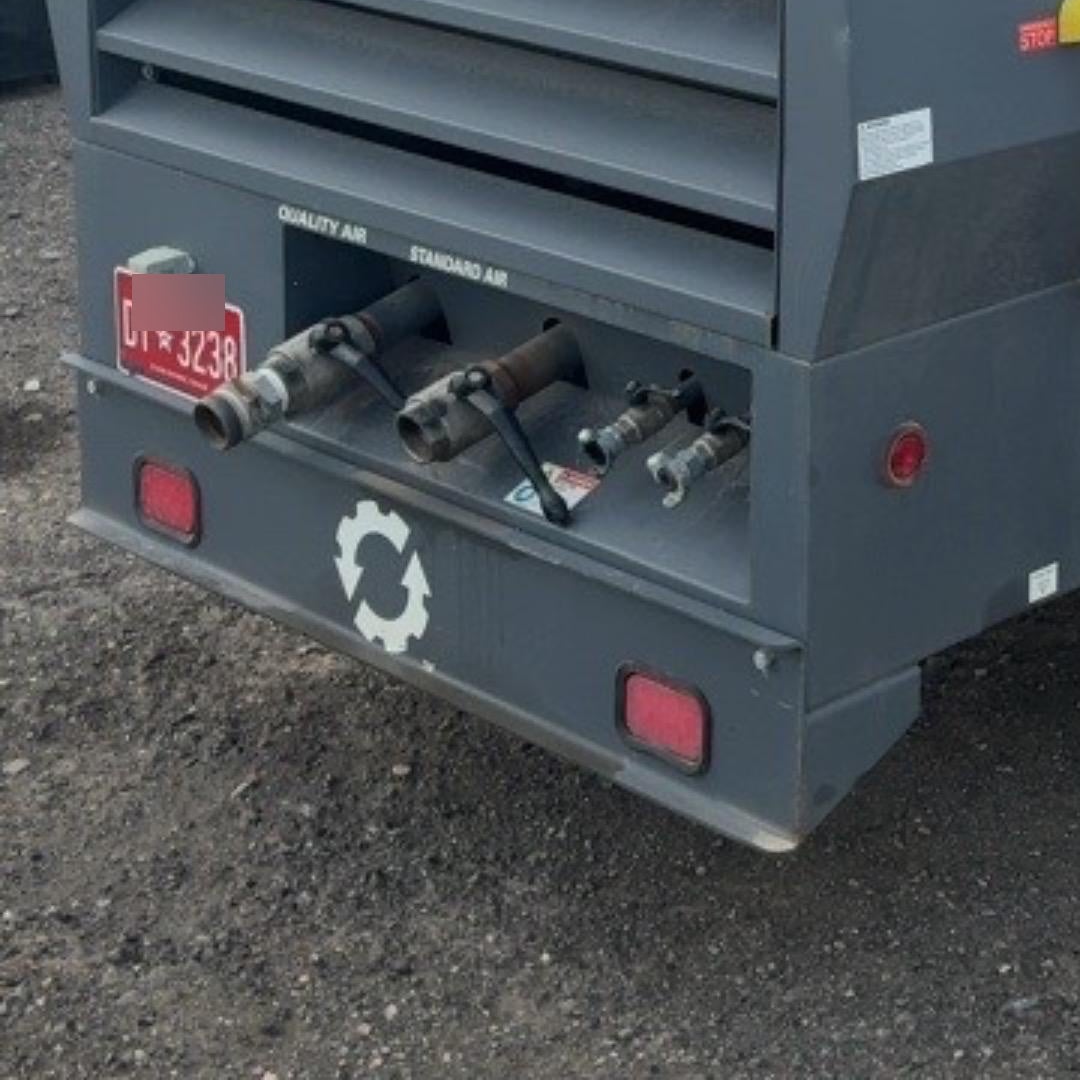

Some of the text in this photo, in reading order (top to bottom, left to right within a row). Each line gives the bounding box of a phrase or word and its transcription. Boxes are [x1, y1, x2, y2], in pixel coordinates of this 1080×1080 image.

[1019, 26, 1055, 51] STOP
[278, 204, 367, 245] QUALITY AIR
[410, 245, 509, 288] STANDARD AIR
